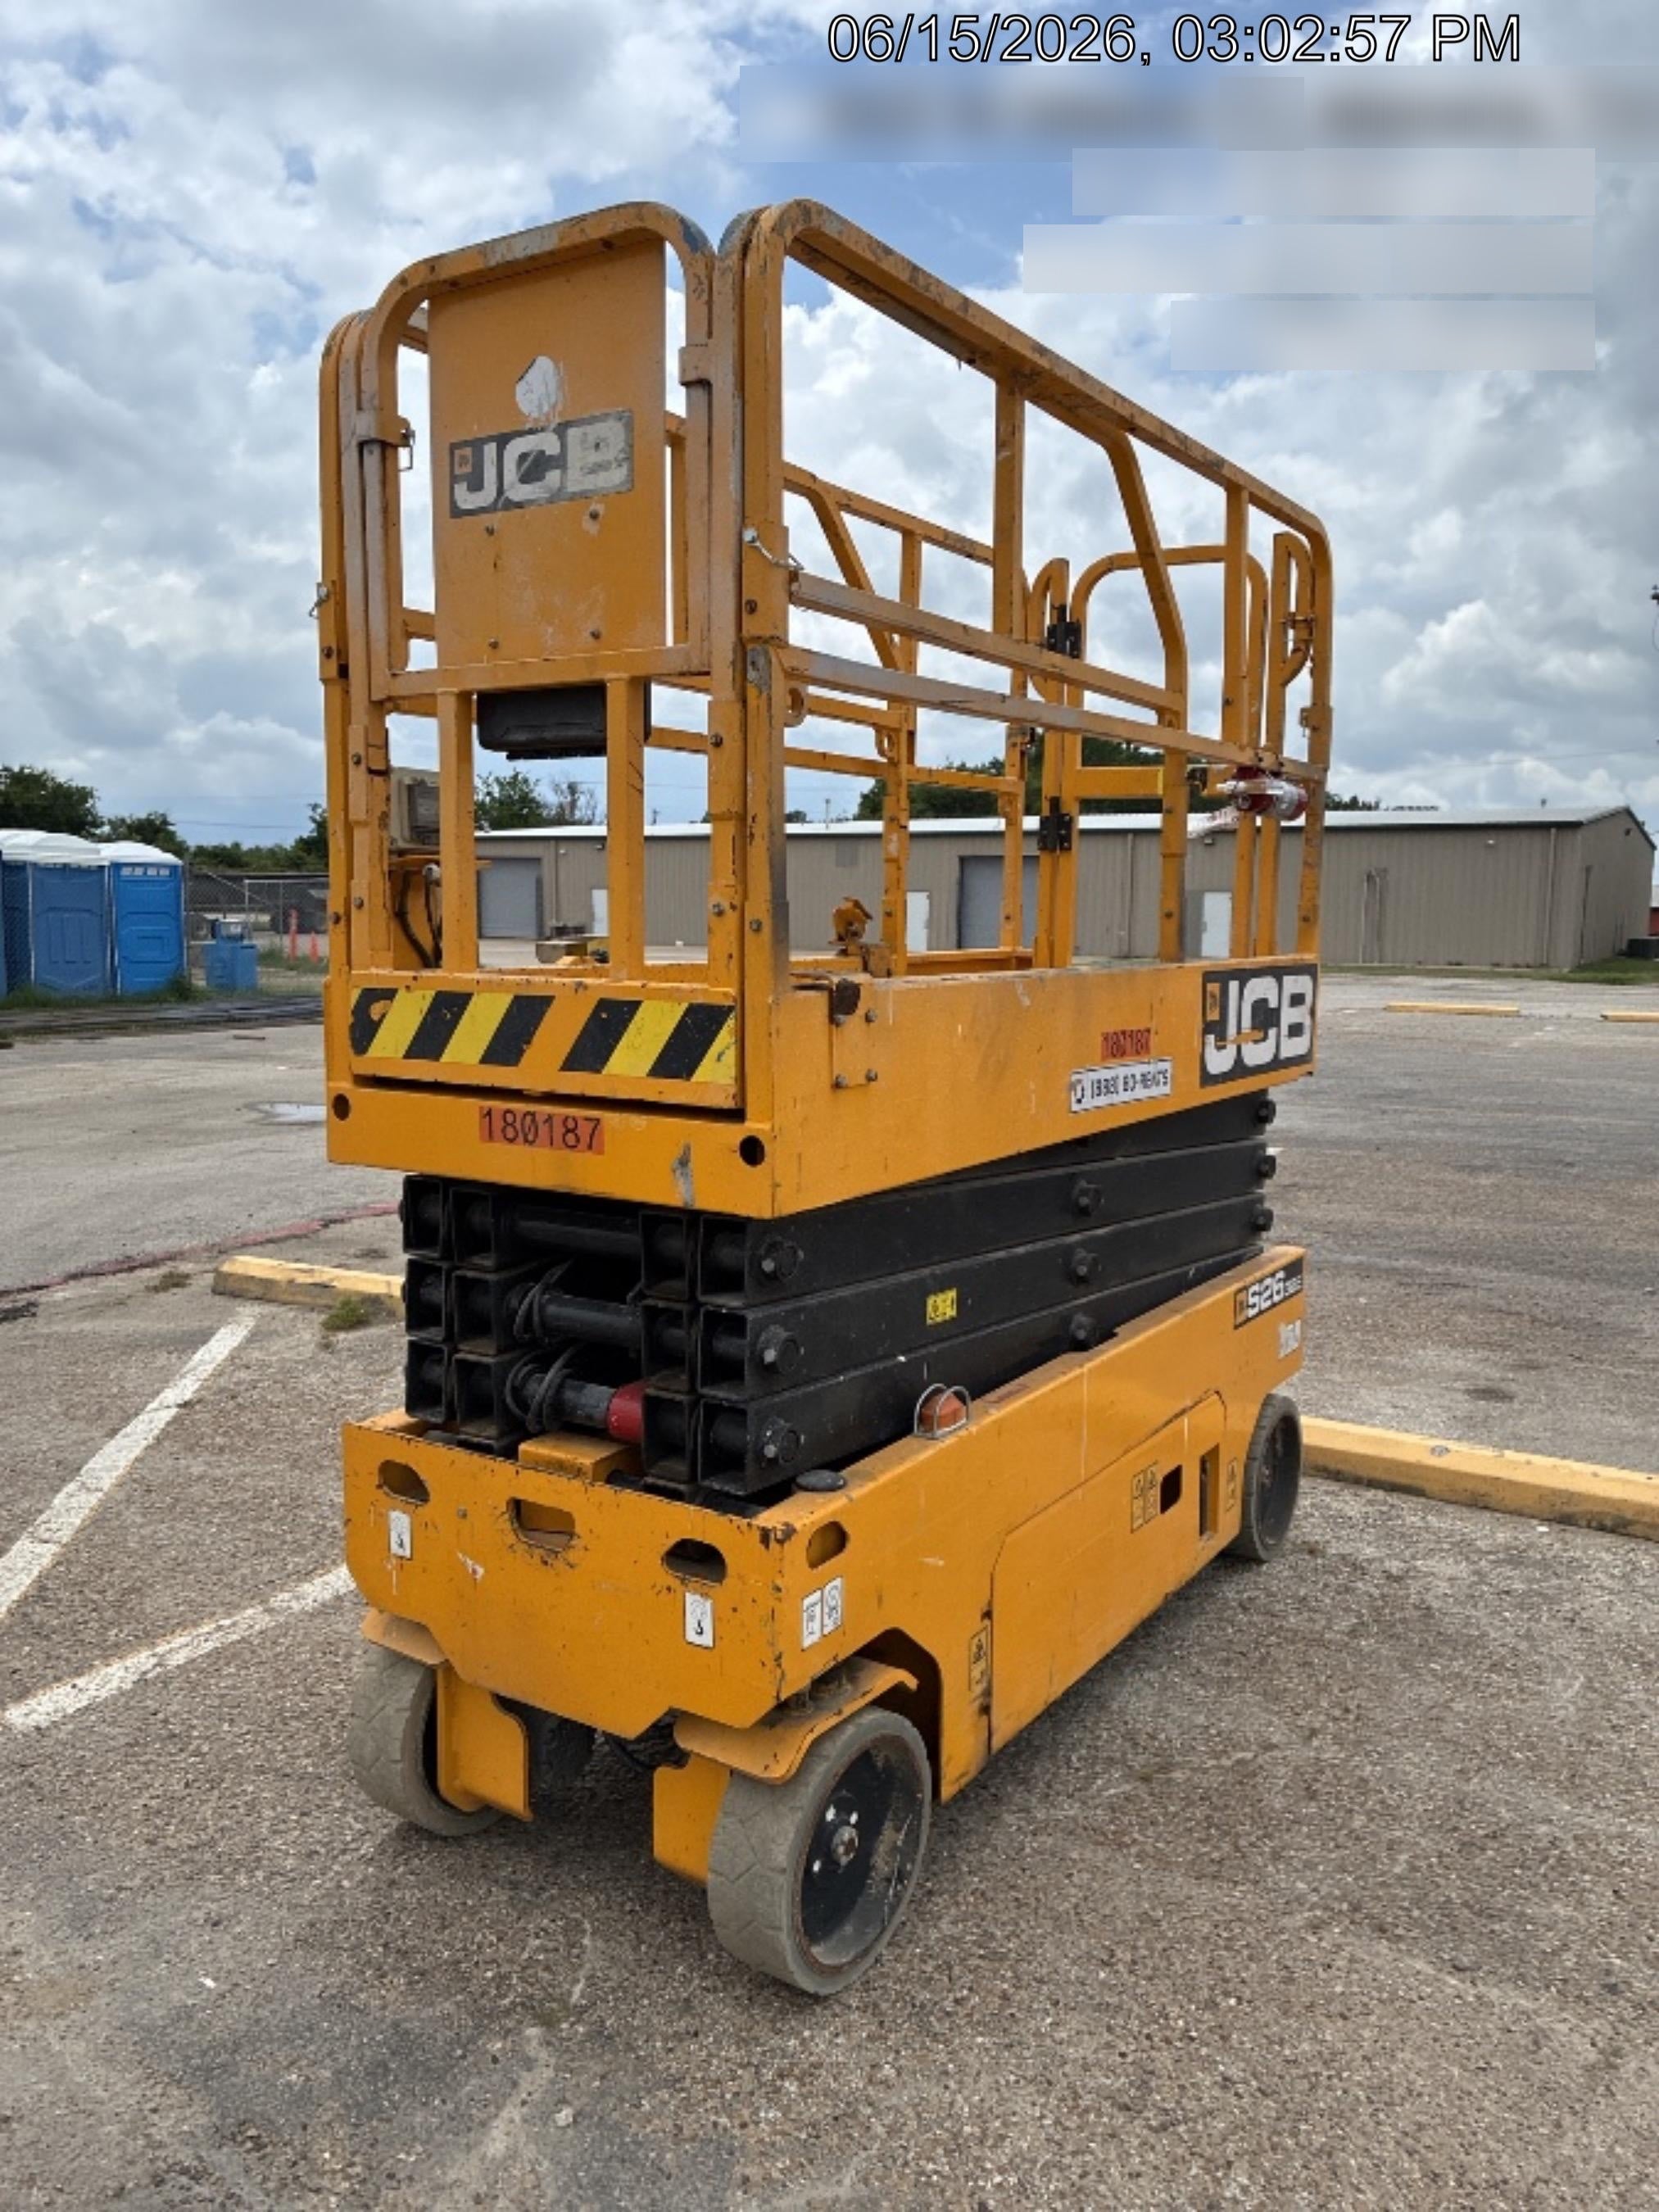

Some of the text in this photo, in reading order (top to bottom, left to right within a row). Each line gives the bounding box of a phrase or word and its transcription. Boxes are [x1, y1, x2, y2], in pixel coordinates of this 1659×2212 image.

[453, 421, 629, 510] JCB
[1204, 975, 1313, 1075] JCB
[482, 1107, 601, 1151] 180187
